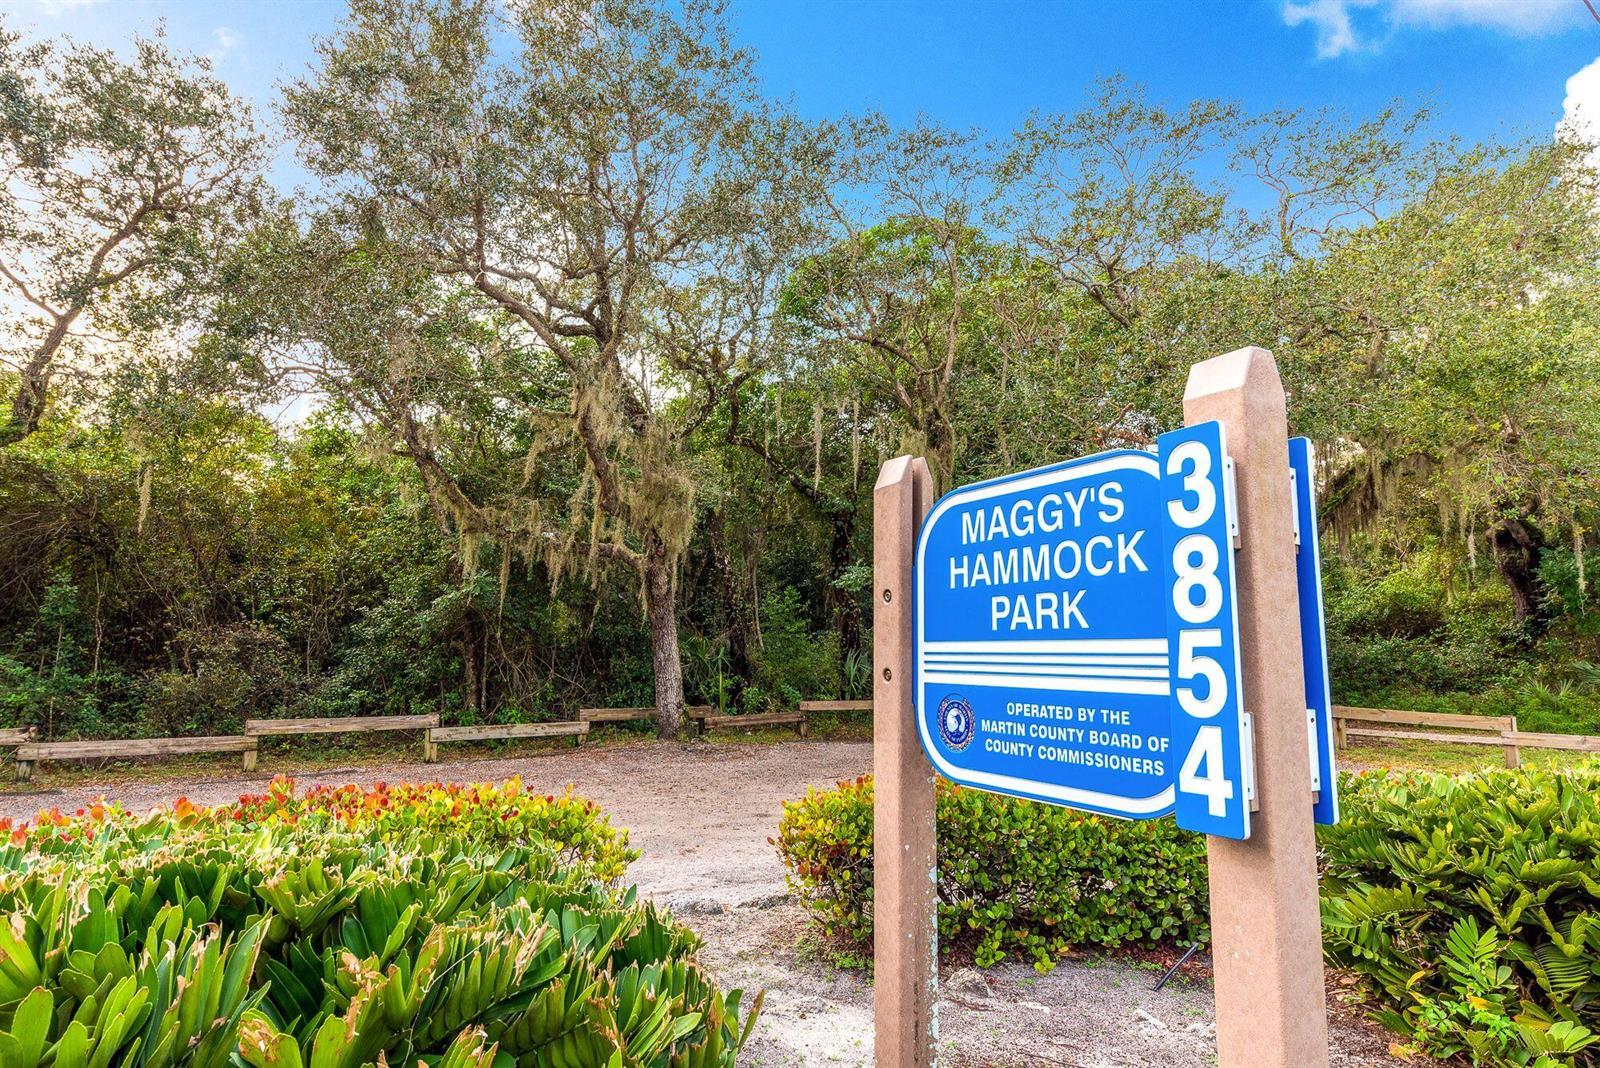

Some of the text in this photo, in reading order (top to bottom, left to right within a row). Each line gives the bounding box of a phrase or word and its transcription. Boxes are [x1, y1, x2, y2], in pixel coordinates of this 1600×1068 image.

[962, 481, 1125, 545] MAGGY'S
[950, 530, 1149, 589] HAMMOCK
[991, 589, 1089, 631] PARK
[1006, 702, 1130, 726] OPERATED BY THE
[981, 719, 1026, 736] MARTIN
[1029, 724, 1084, 743] COUNTY
[1089, 730, 1142, 749] BOARD
[1147, 736, 1169, 753] OF
[985, 739, 1165, 777] COUNTY COMMISSIONERS
